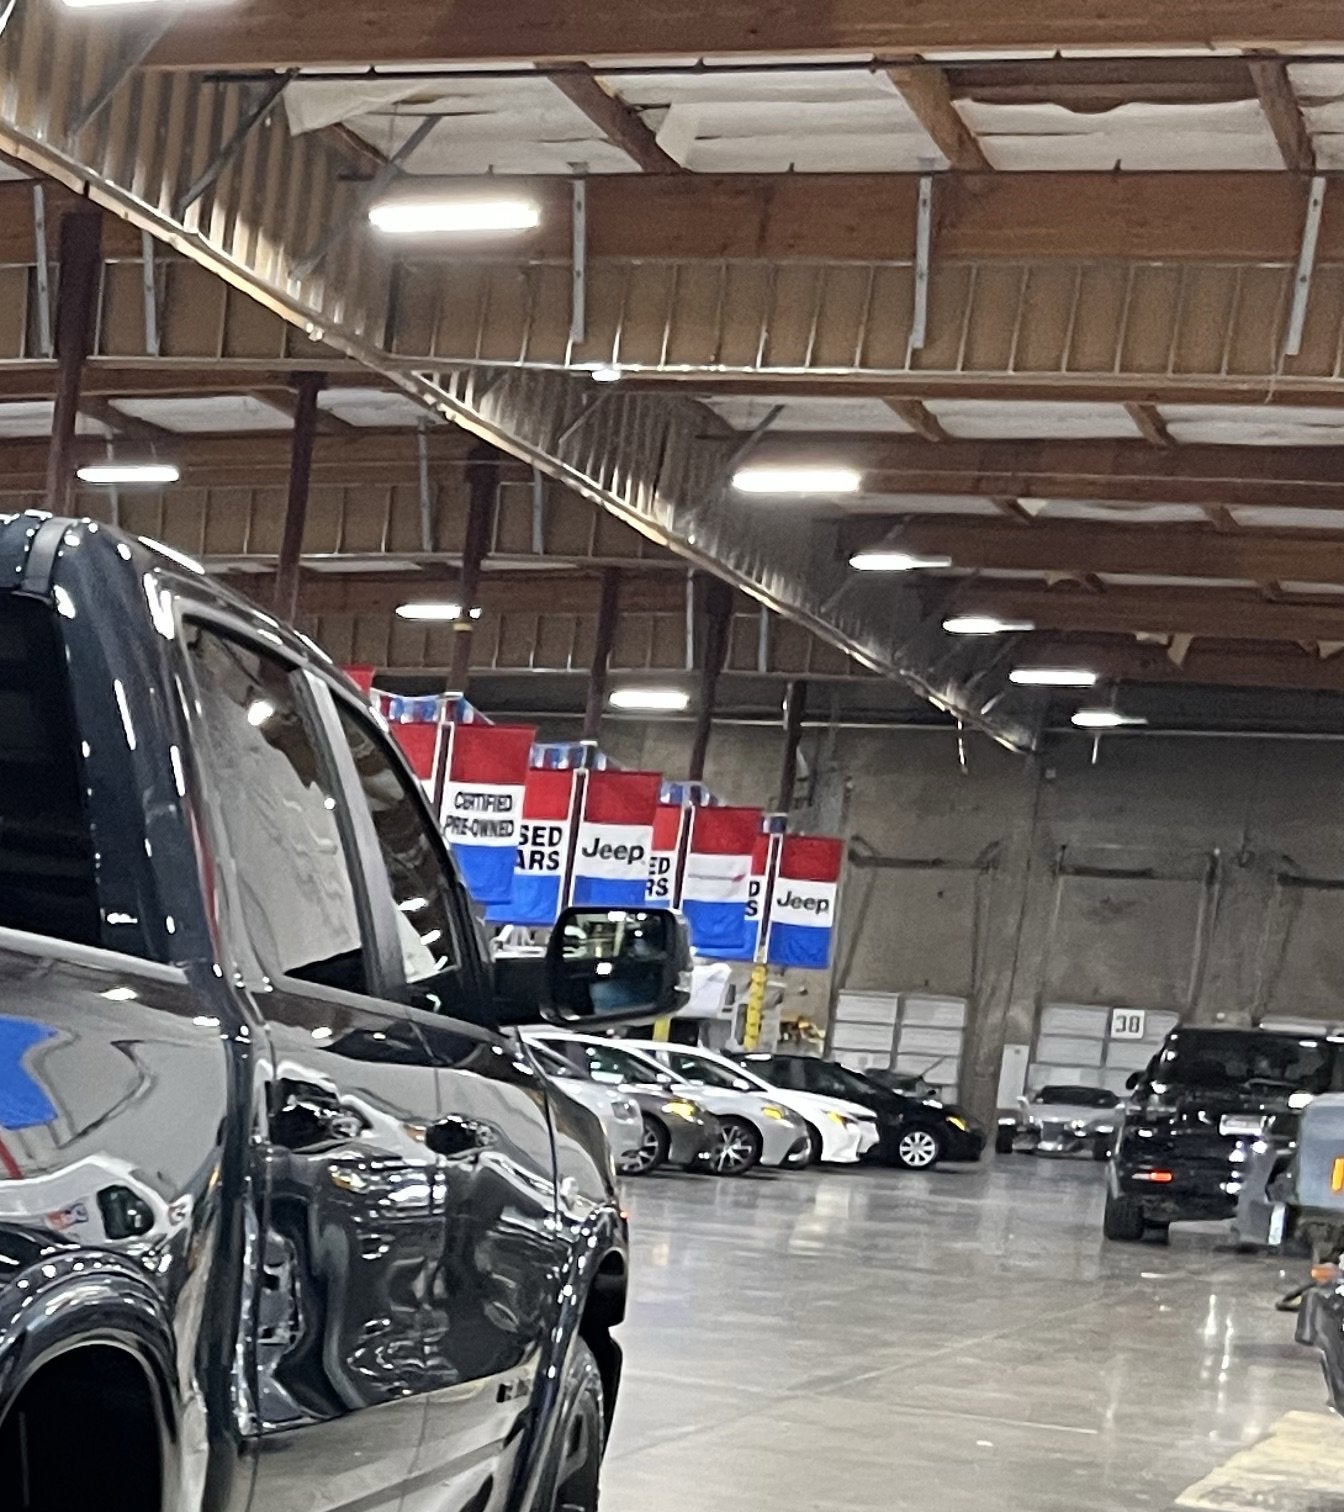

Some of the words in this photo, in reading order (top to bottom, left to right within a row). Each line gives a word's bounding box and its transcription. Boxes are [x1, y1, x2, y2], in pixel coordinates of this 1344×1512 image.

[518, 824, 563, 848] SED
[515, 850, 560, 871] ARS
[581, 837, 645, 865] Jeep
[777, 890, 830, 915] Jeep
